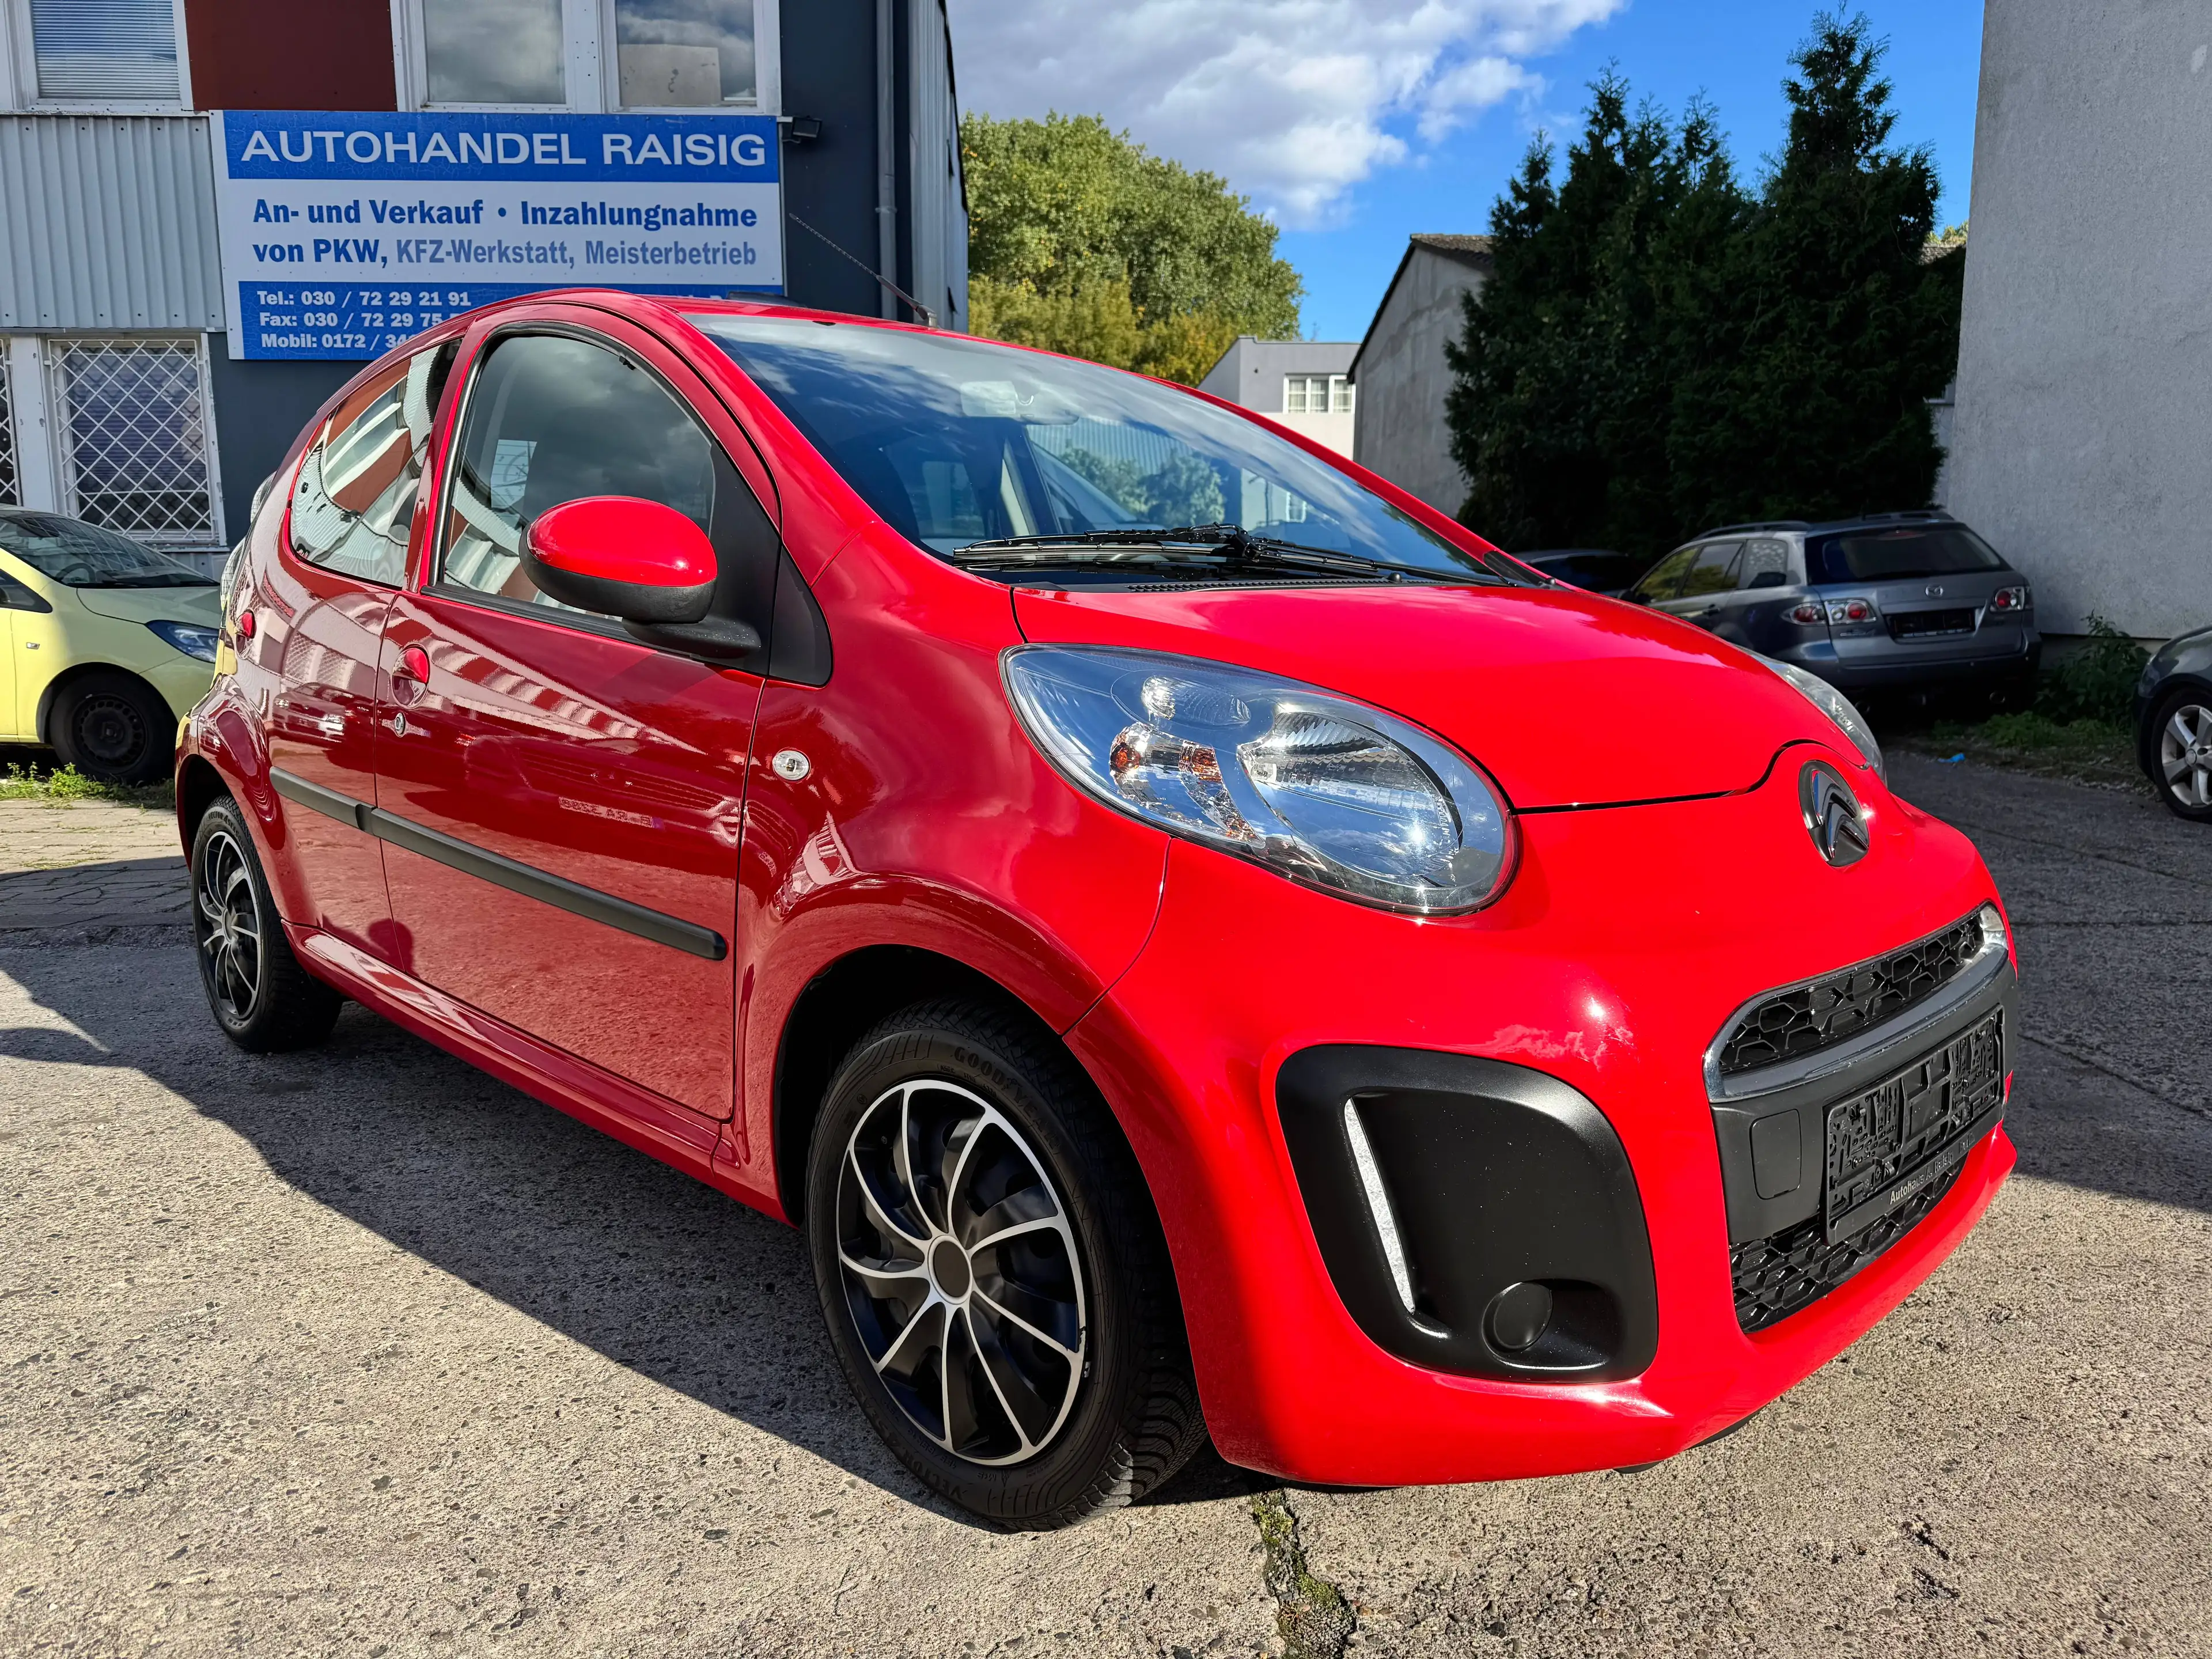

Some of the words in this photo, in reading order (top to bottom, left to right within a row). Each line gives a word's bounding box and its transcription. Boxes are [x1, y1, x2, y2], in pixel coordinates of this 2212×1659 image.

[241, 130, 586, 165] AUTOHANDEL
[602, 134, 766, 166] RAISIG
[253, 199, 299, 223] An-
[308, 199, 361, 224] und
[369, 199, 483, 224] Verkauf
[521, 201, 757, 231] Inzahlungnahme
[252, 244, 304, 262] von
[313, 238, 388, 268] PKW,
[396, 239, 574, 269] KFZ-Werkstatt,
[585, 240, 756, 265] Meisterbetrieb
[257, 290, 294, 305] Tel.:
[301, 291, 335, 305] 030
[341, 291, 352, 308] /
[359, 291, 382, 306] 72
[389, 291, 412, 306] 29
[419, 291, 442, 306] 21
[448, 291, 471, 306] 91
[260, 312, 297, 327] Fax:
[304, 313, 338, 327] 030
[343, 313, 354, 329] /
[362, 313, 384, 327] 72
[391, 313, 413, 327] 29
[420, 313, 442, 327] 75
[262, 334, 317, 348] Mobil:
[323, 334, 366, 349] 0172
[369, 334, 380, 351] /
[385, 334, 415, 349] 34
[1889, 1175, 1924, 1205] Autohaus
